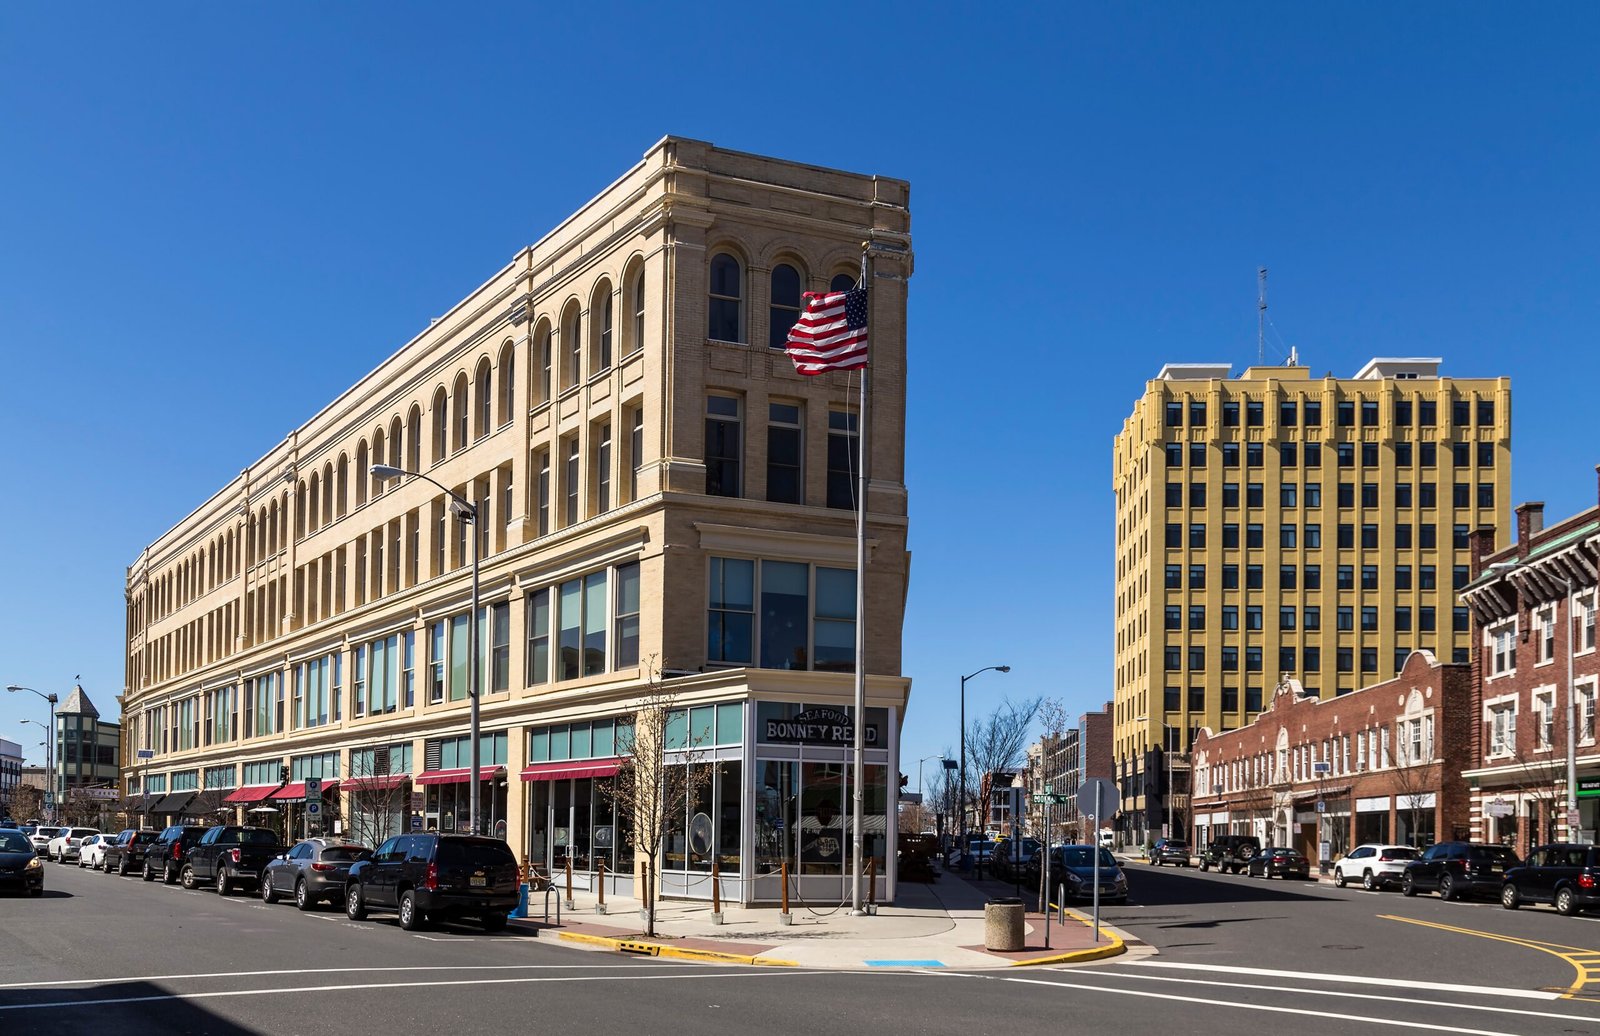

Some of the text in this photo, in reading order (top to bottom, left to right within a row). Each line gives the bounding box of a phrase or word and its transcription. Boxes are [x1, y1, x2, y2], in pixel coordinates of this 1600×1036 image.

[799, 709, 849, 726] SEAFOOD
[767, 722, 877, 742] BONNEY RED
